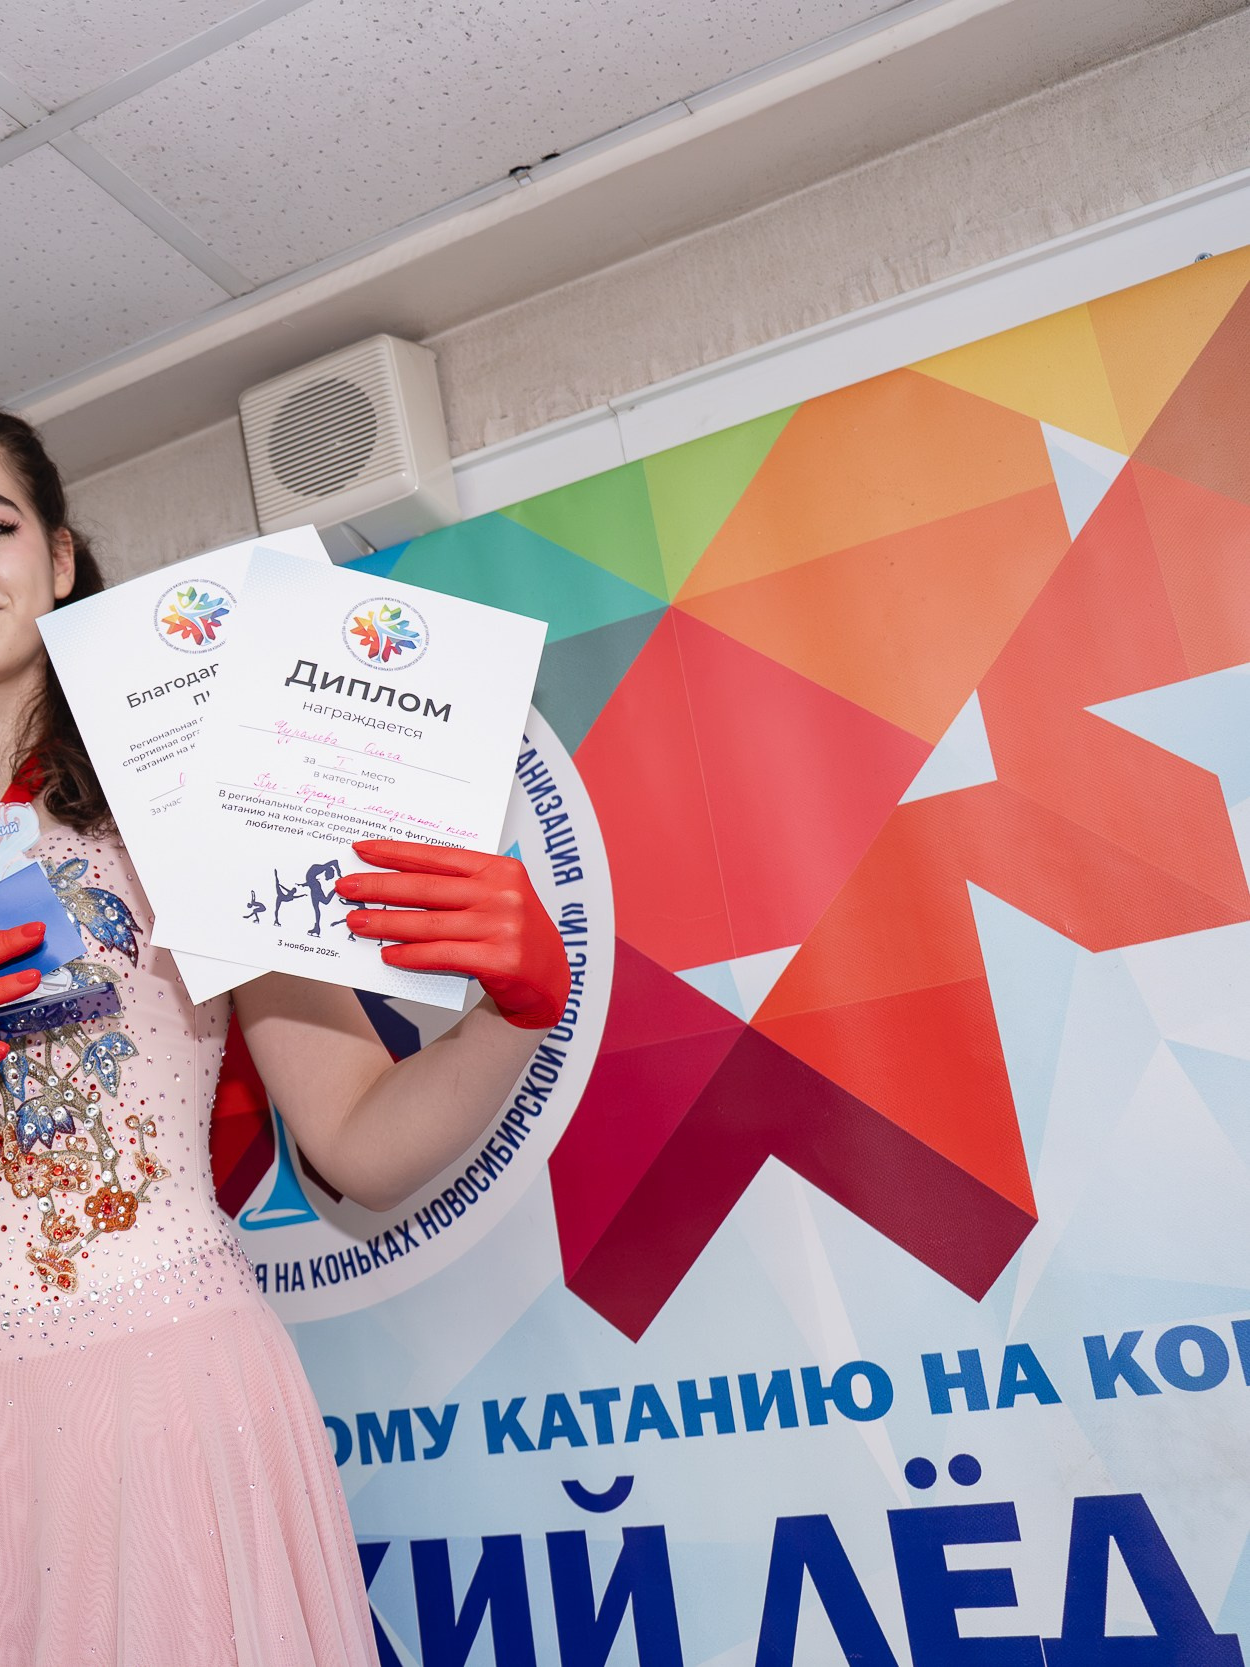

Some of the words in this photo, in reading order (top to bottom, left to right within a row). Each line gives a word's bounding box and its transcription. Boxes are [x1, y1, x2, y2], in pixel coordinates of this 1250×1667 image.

[126, 663, 219, 708] Благодар
[193, 690, 210, 706] п
[284, 659, 452, 722] Диплом
[129, 718, 198, 752] Региональная
[302, 701, 423, 740] награждается
[122, 738, 179, 767] спортивная
[136, 752, 175, 773] катания
[176, 745, 188, 755] на
[303, 756, 316, 764] за
[360, 770, 396, 785] место
[313, 770, 320, 778] в
[322, 774, 379, 792] категории
[150, 807, 162, 817] За
[218, 789, 226, 797] В
[228, 791, 303, 812] региональных
[305, 806, 387, 831] соревнованиях
[390, 826, 403, 835] по
[221, 802, 266, 817] катанию
[268, 811, 280, 820] на
[282, 814, 325, 828] коньках
[327, 822, 360, 835] среди
[515, 734, 584, 887] АНИЗАЦИЯ
[245, 819, 304, 836] любителей
[277, 939, 283, 947] 3
[284, 942, 315, 952] ноября
[315, 947, 341, 958] 2025г.
[275, 1261, 306, 1293] НА
[309, 1219, 420, 1289] КОНЬКАХ
[482, 1360, 894, 1455] КАТАНИЮ
[920, 1342, 1063, 1415] НА
[754, 1453, 1246, 1667] ЛЁД
